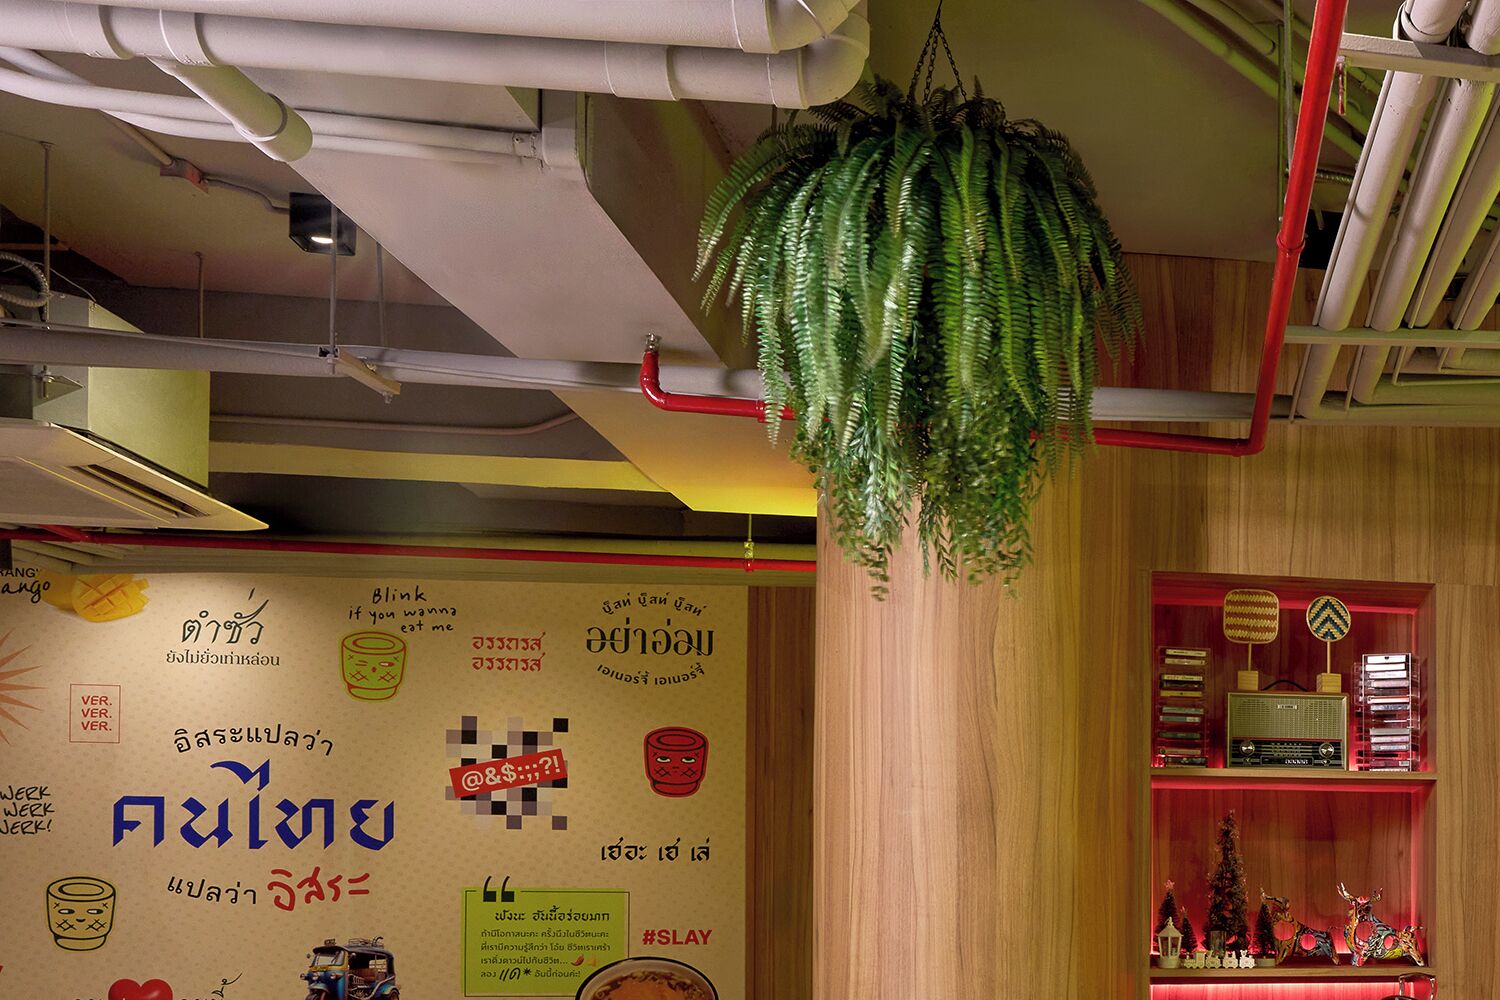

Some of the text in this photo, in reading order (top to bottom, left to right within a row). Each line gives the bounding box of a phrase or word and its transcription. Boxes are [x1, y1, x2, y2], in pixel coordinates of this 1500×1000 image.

[372, 585, 427, 604] Blink
[181, 587, 270, 645] ตำซั่ว
[349, 606, 457, 625] if you wanna
[401, 620, 454, 633] eat me
[586, 617, 715, 656] อย่าอ่อม
[166, 648, 281, 666] ยังไม่ยั่วเท่าหล่อน
[81, 695, 113, 706] VER.
[81, 708, 113, 719] VER.
[81, 721, 113, 731] VER.
[173, 723, 334, 756] อิสระแปลว่า
[0, 785, 51, 800] WERK
[3, 802, 55, 817] WERK
[112, 758, 395, 851] คนไทย
[167, 866, 370, 912] แปลว่า อิสระ
[494, 910, 526, 922] ฟังนะ
[642, 929, 713, 946] #SLAY
